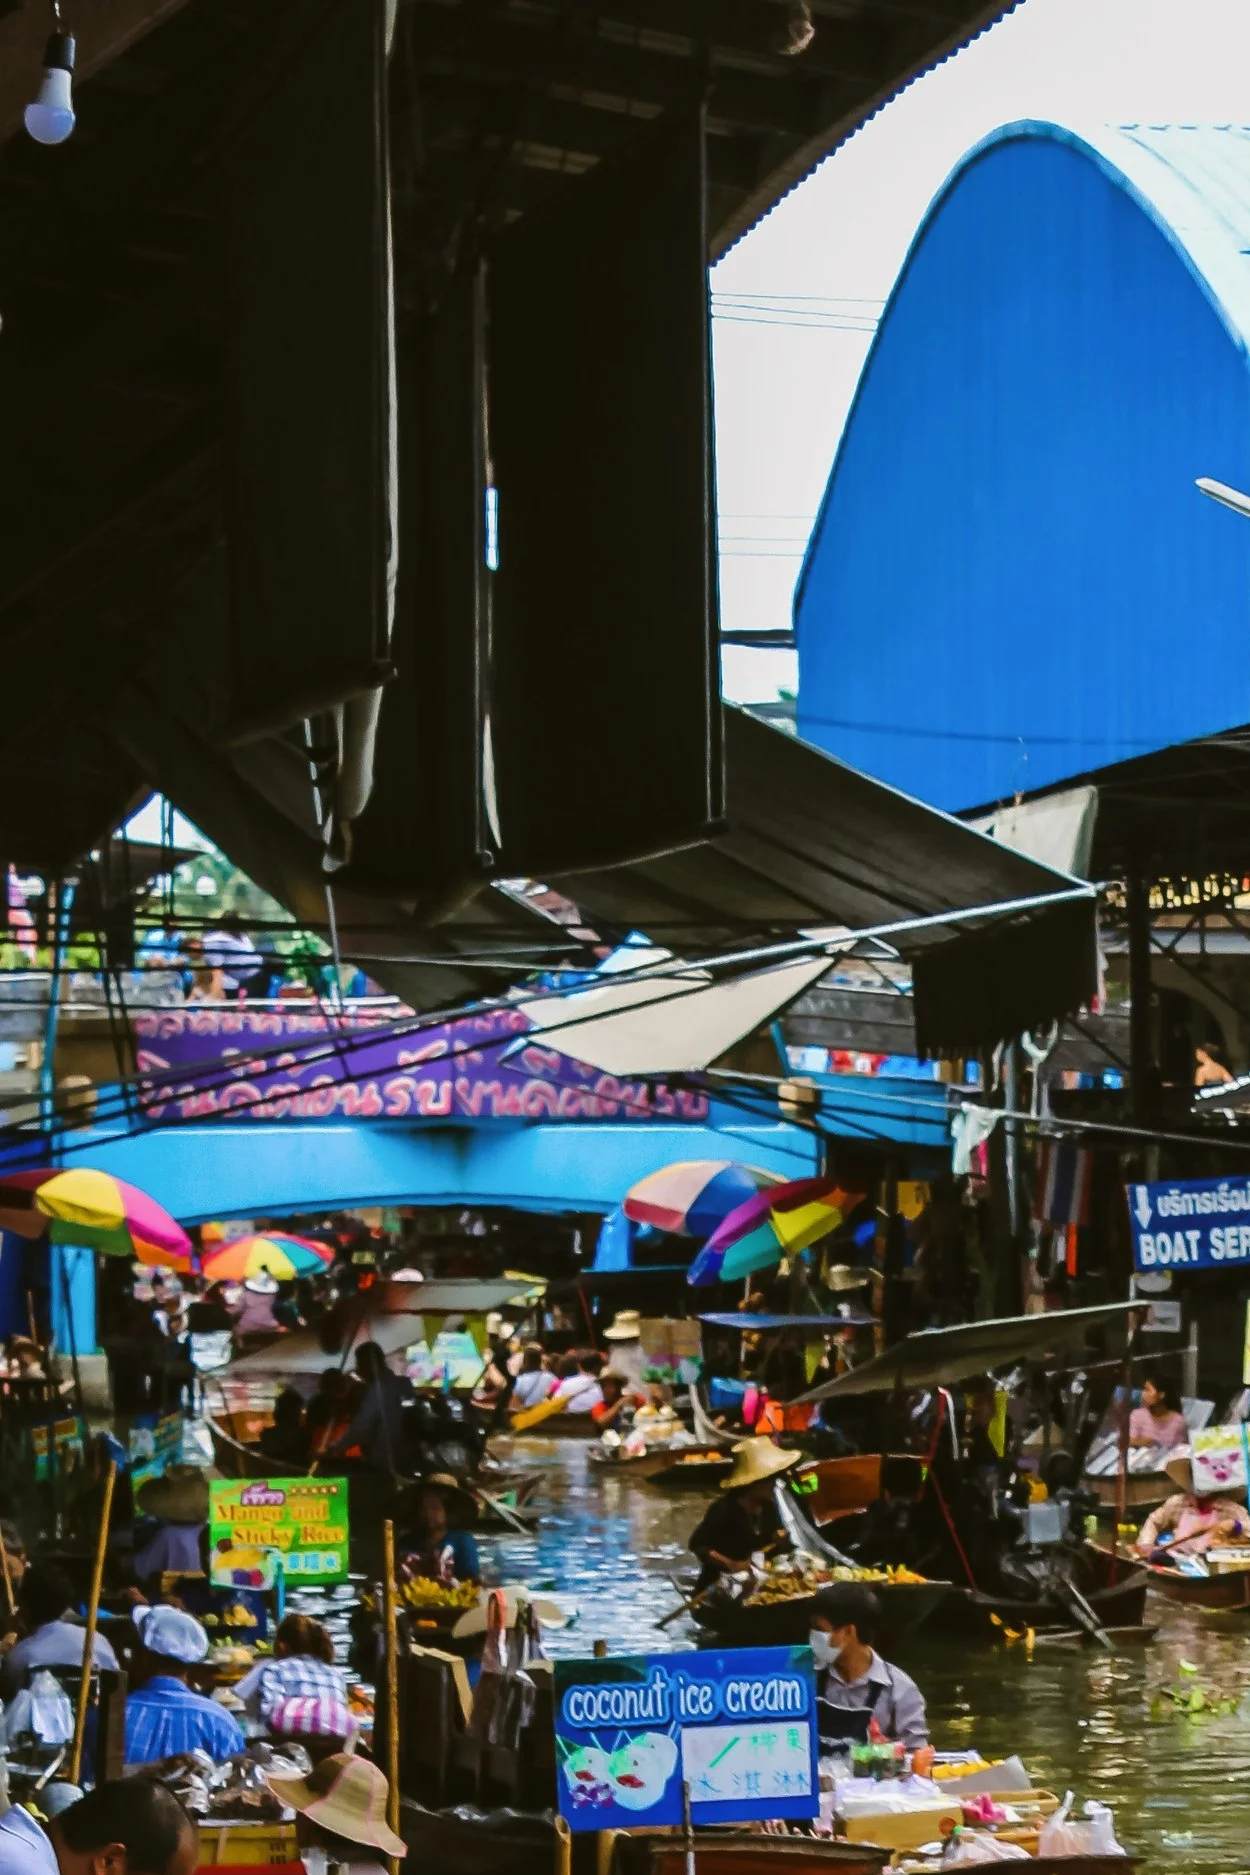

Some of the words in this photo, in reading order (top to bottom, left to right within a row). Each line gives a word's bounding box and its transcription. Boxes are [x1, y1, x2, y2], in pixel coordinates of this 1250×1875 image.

[1139, 1229, 1201, 1265] BOAT
[217, 1504, 283, 1523] Mango
[291, 1500, 328, 1520] and
[233, 1526, 292, 1547] Sticky
[302, 1525, 344, 1543] Rice
[569, 1671, 666, 1721] coconut
[678, 1676, 713, 1715] ice
[726, 1678, 801, 1713] cream
